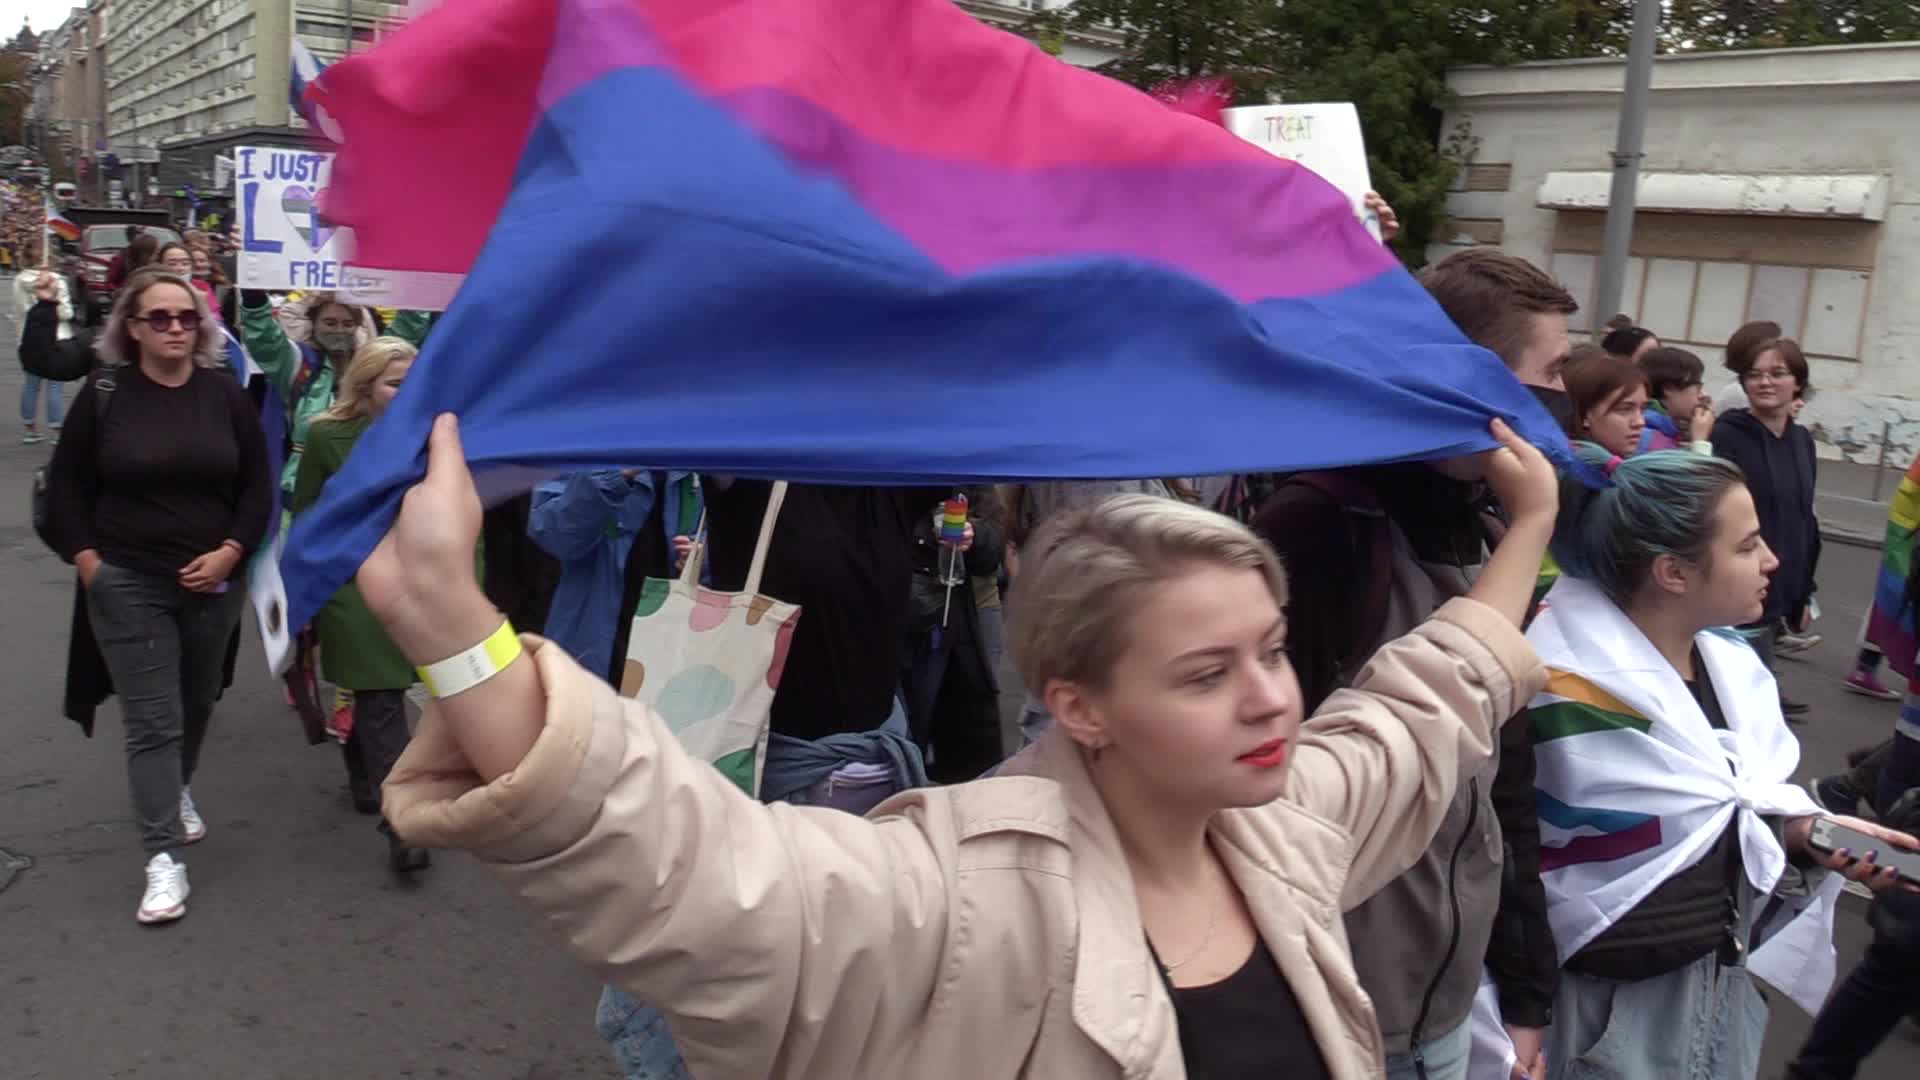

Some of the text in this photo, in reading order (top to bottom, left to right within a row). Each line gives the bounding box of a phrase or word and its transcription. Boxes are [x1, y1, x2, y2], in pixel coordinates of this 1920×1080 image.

[1263, 115, 1315, 142] TREAT
[238, 149, 327, 182] I JUST
